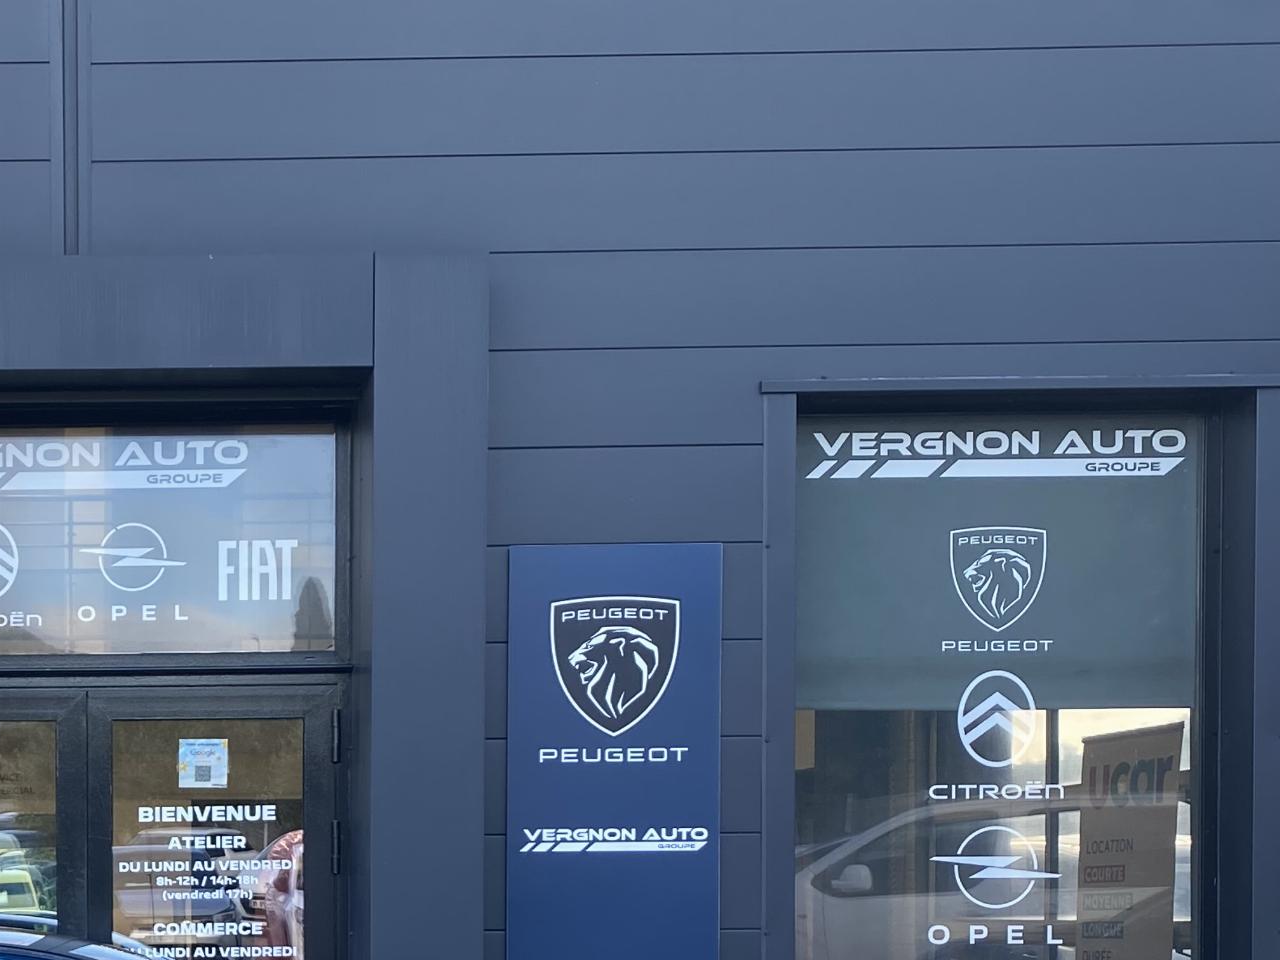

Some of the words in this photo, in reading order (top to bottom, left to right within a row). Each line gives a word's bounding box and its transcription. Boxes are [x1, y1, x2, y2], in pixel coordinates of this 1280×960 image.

[813, 431, 1048, 456] VERGNON
[1053, 429, 1186, 454] AUTO
[115, 440, 248, 466] AUTO
[1085, 462, 1161, 472] GROUPE
[146, 473, 224, 484] GROUPE
[958, 535, 1038, 546] PEUGEOT
[218, 539, 298, 600] FIAT
[77, 604, 189, 622] OPEL
[562, 608, 668, 622] PEUGEOT
[941, 640, 1054, 652] PEUGEOT
[539, 747, 689, 763] PEUGEOT
[928, 780, 1064, 800] CITROËN
[138, 805, 277, 823] BIENVENUE
[523, 828, 637, 841] VERGNON
[641, 827, 709, 841] AUTO
[168, 835, 247, 850] ATELIER
[1086, 838, 1134, 855] LOCATION
[118, 861, 141, 873] DU
[144, 861, 189, 872] LUNDI
[193, 860, 216, 872] AU
[156, 876, 199, 887] 8h-12h
[201, 876, 208, 887] /
[209, 875, 258, 886] 14h-18h
[1085, 867, 1124, 882] COURTE
[162, 890, 224, 901] (vendredi
[226, 889, 254, 900] 17h)
[153, 922, 263, 936] COMMERCE
[927, 924, 1063, 945] OPEL
[145, 946, 190, 958] LUNDI
[193, 946, 216, 958] AU
[219, 946, 297, 958] VENDREDI
